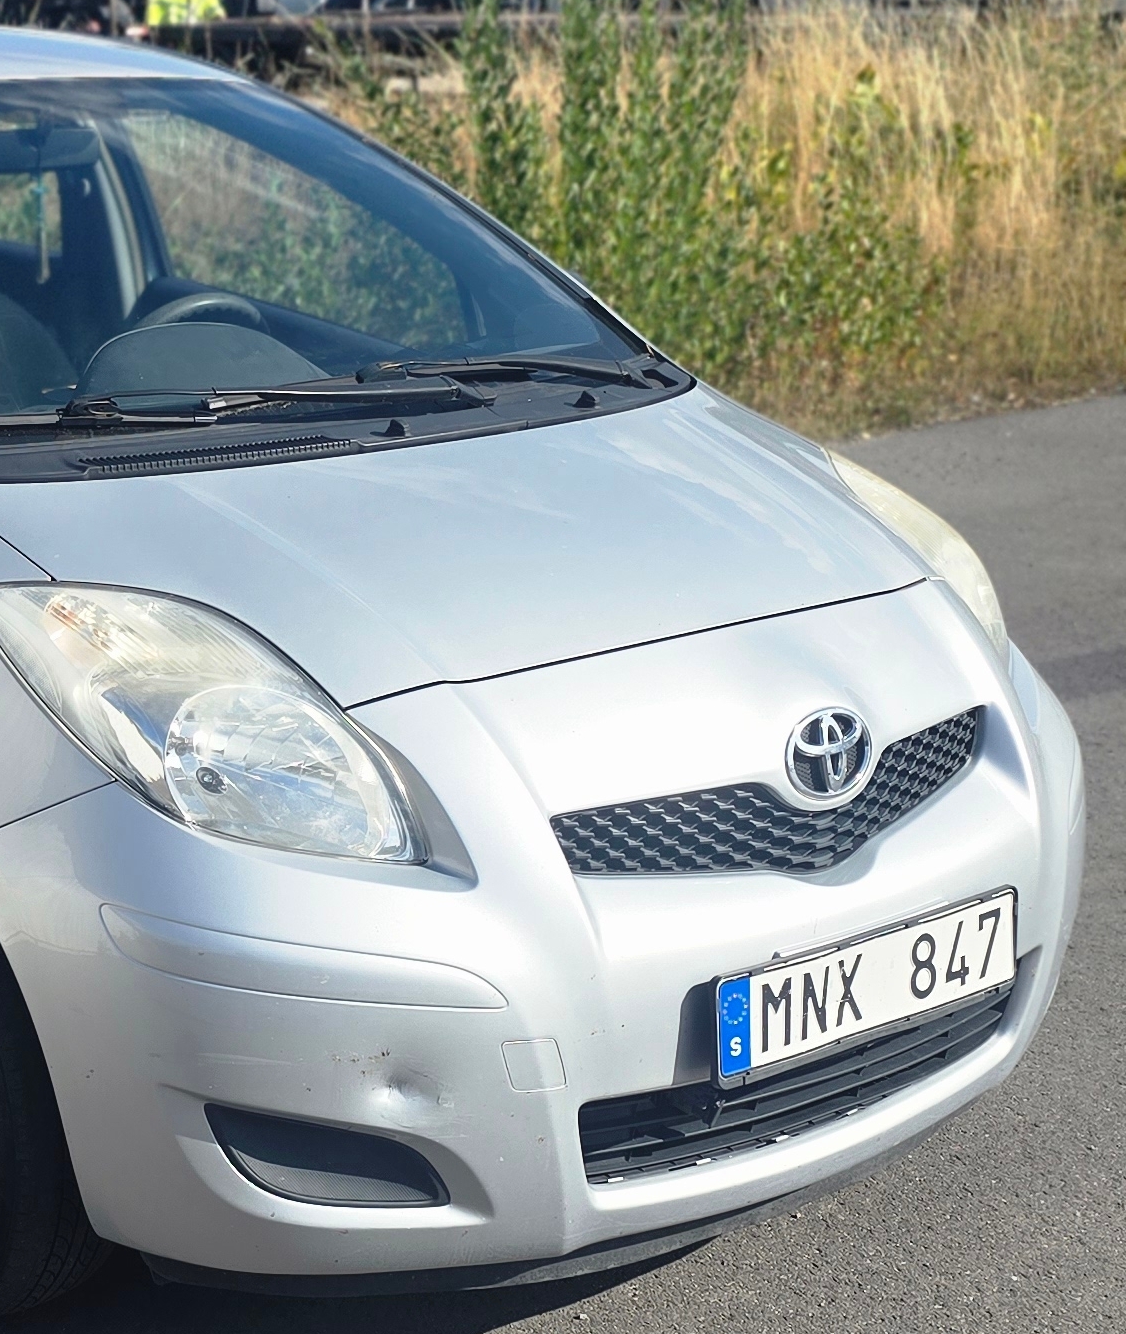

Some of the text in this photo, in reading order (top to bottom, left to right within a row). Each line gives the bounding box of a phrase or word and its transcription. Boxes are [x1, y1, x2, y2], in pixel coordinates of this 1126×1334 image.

[761, 907, 1001, 1053] MNX 847
[729, 1036, 742, 1057] S
